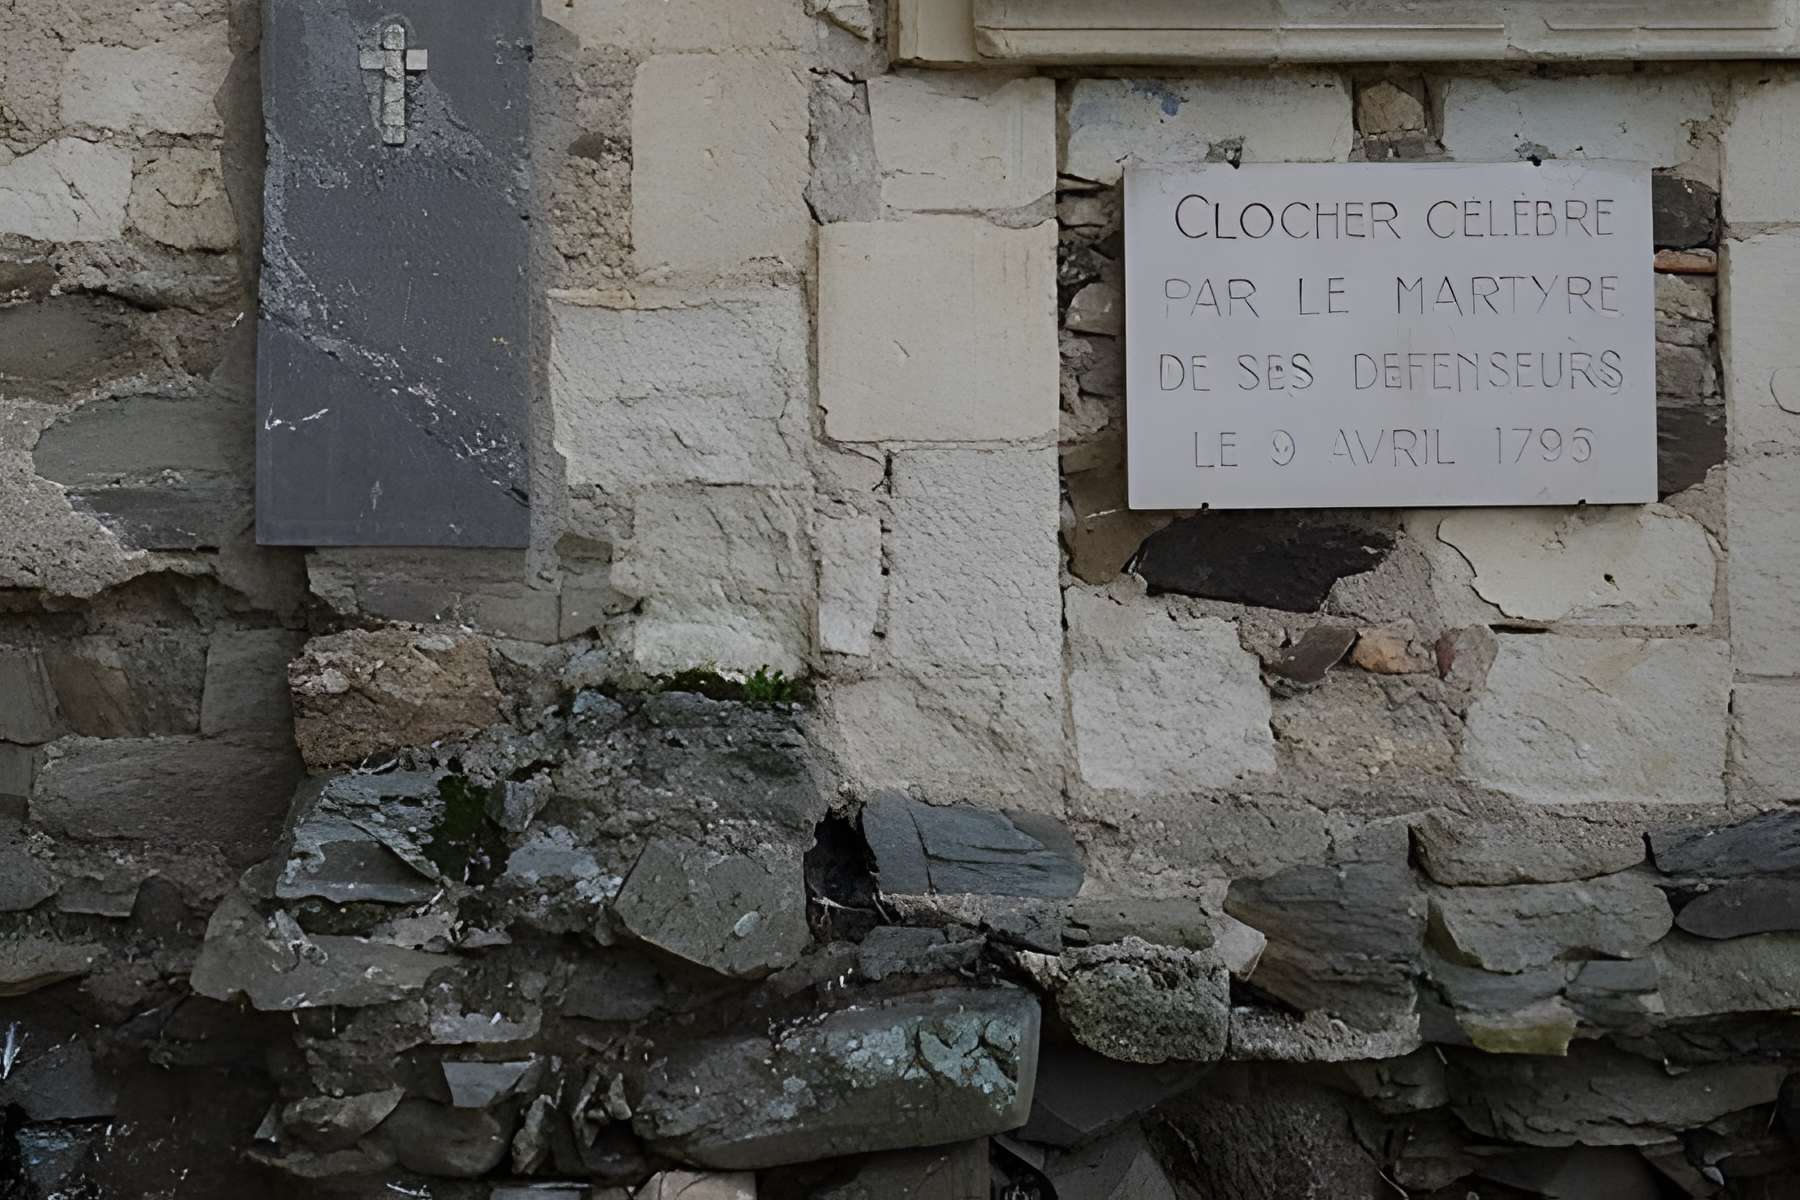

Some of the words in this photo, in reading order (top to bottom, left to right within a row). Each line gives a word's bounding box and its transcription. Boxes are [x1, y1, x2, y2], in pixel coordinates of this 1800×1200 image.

[1175, 193, 1401, 240] CLOCHER
[1164, 277, 1260, 318] PAR
[1298, 276, 1350, 316] LE
[1396, 275, 1625, 317] MARTYRE
[1159, 353, 1211, 392] DE
[1237, 351, 1314, 392] SES
[1194, 431, 1239, 468] LE
[1271, 428, 1297, 467] 9
[1331, 427, 1456, 468] AVRIL
